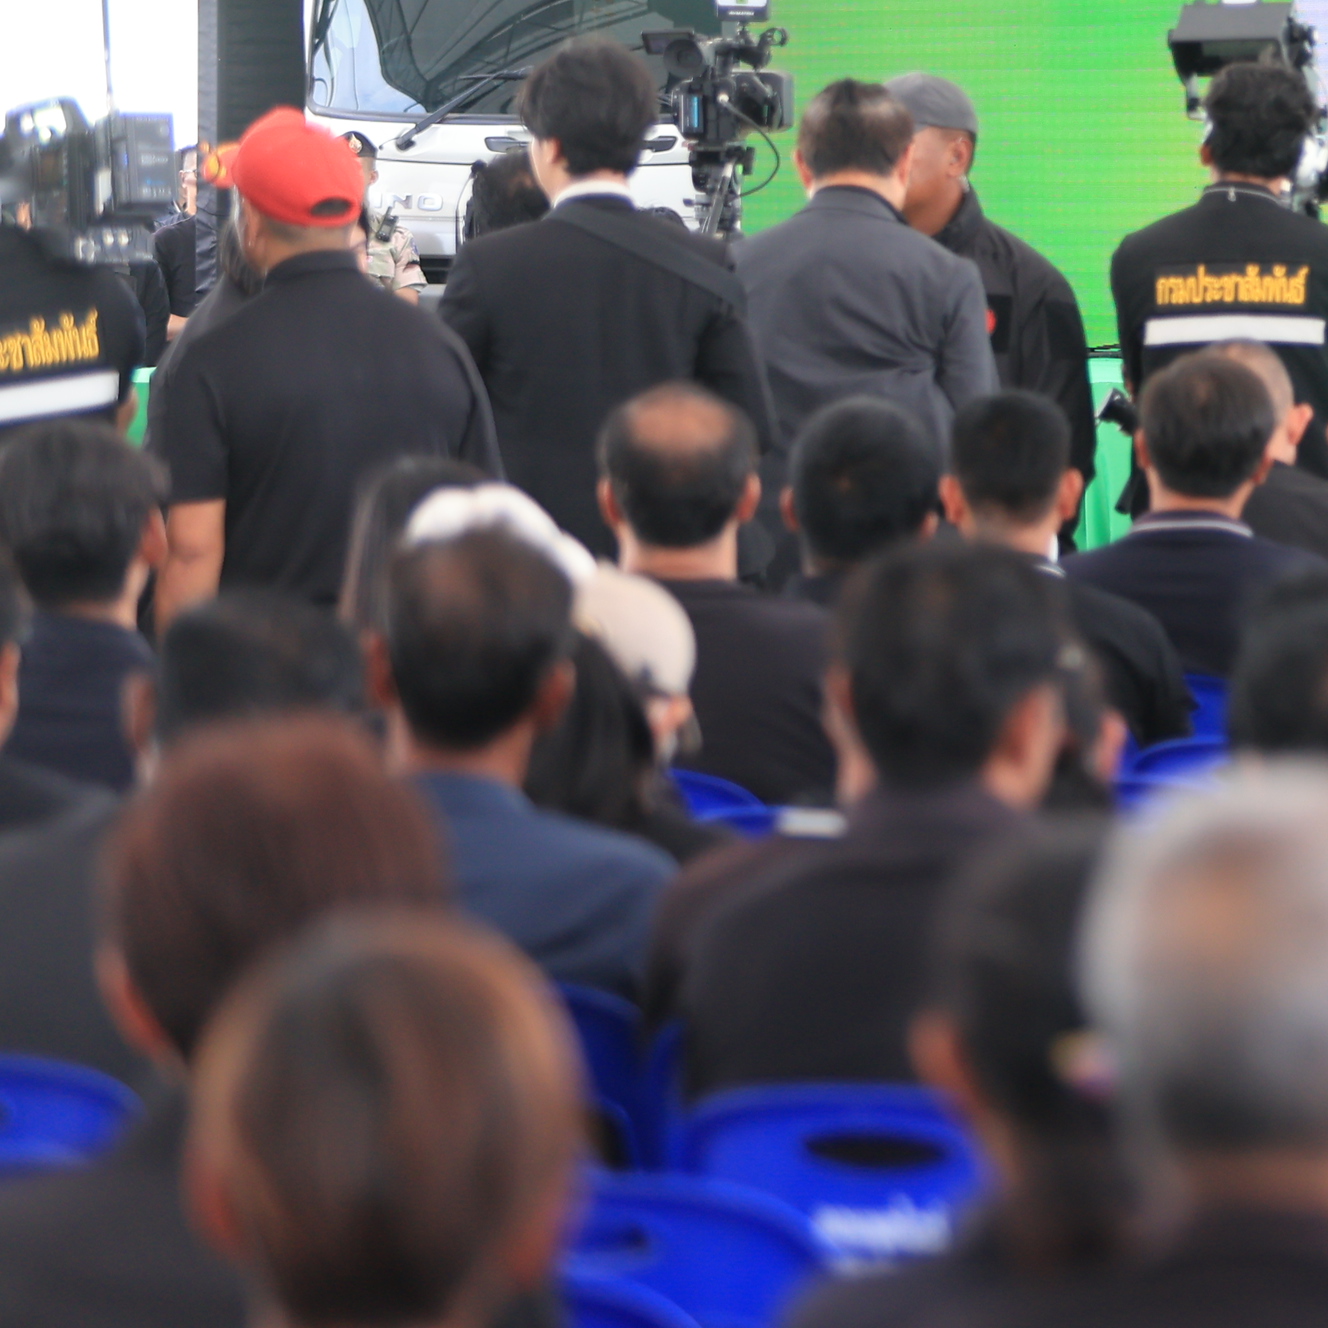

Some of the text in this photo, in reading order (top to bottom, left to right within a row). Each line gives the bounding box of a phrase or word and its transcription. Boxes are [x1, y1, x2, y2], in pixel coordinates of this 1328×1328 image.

[0, 306, 100, 371] ะชาสัมพันธ์
